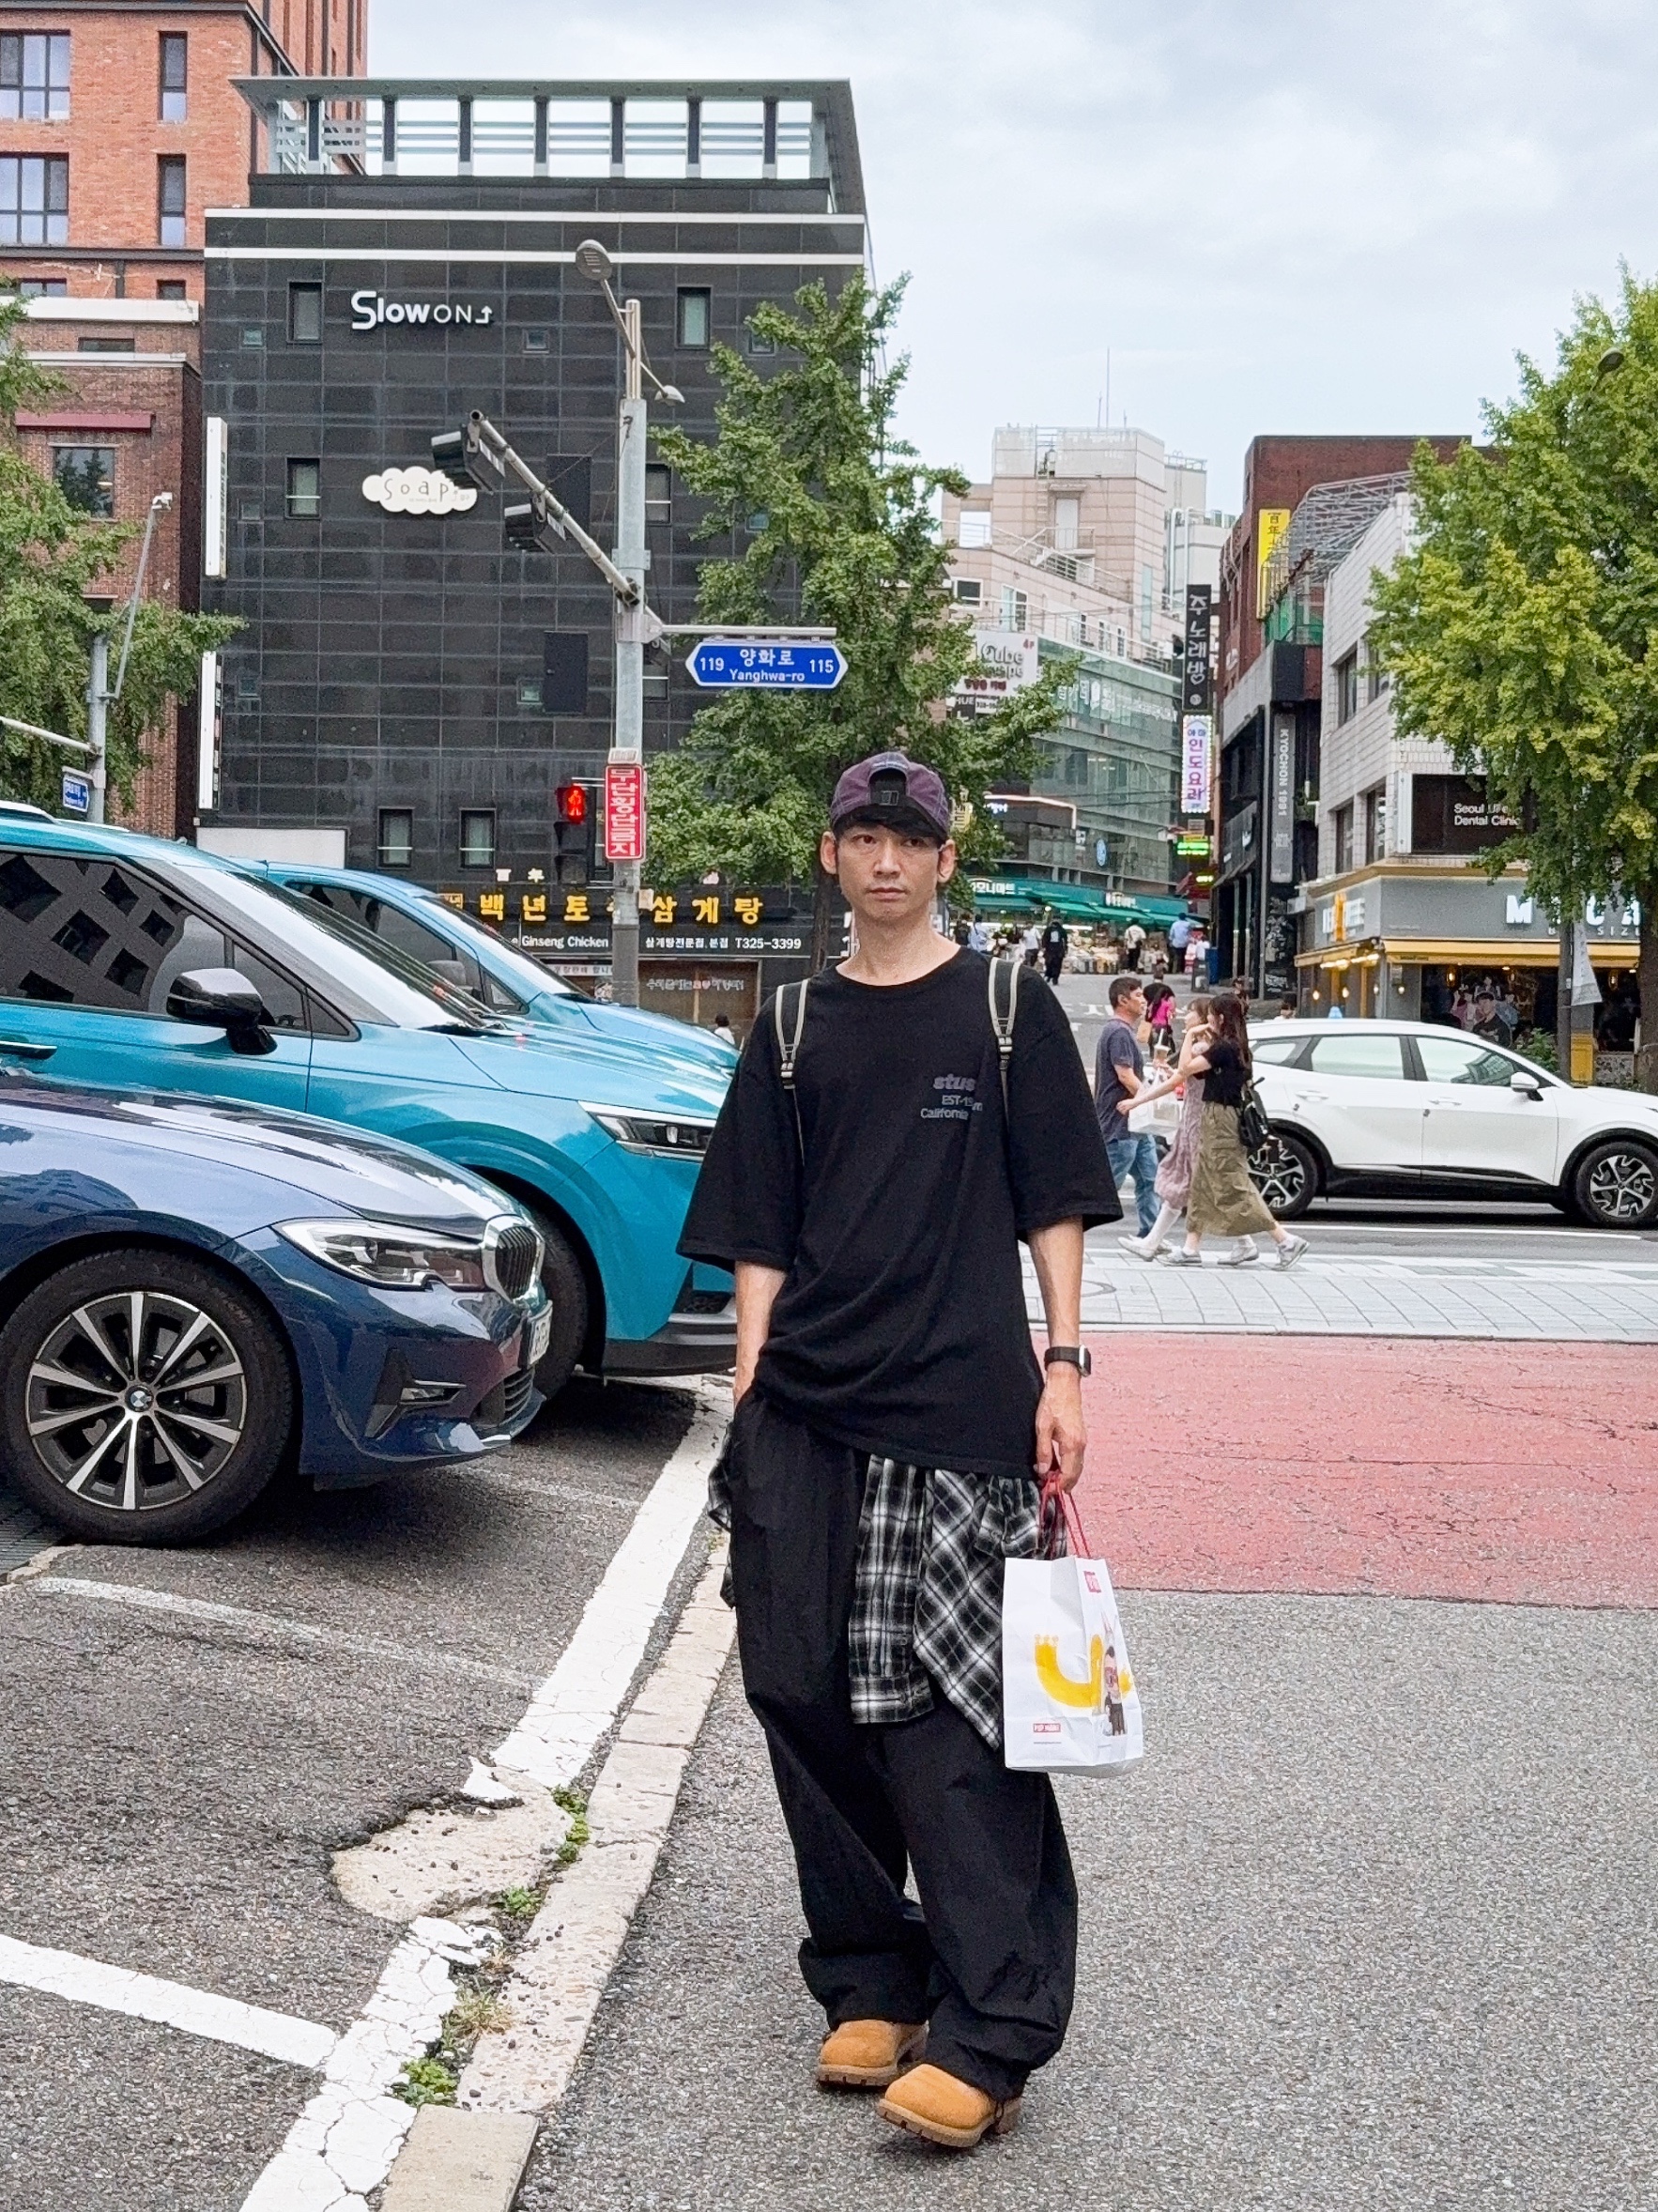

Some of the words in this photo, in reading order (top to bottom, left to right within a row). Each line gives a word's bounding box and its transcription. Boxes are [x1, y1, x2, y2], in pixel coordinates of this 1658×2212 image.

[351, 290, 430, 330] Slow
[433, 303, 472, 324] ON
[699, 657, 725, 672] 119
[740, 648, 795, 668] 양화로
[809, 659, 834, 674] 115
[729, 668, 806, 684] Yanghwa-ro
[610, 768, 639, 857] 무단횡단금지
[1453, 803, 1485, 814] Seoul
[1453, 815, 1489, 826] Dental
[521, 935, 565, 949] Ginseng
[567, 935, 609, 948] Chicken
[735, 937, 802, 950] T325-3399
